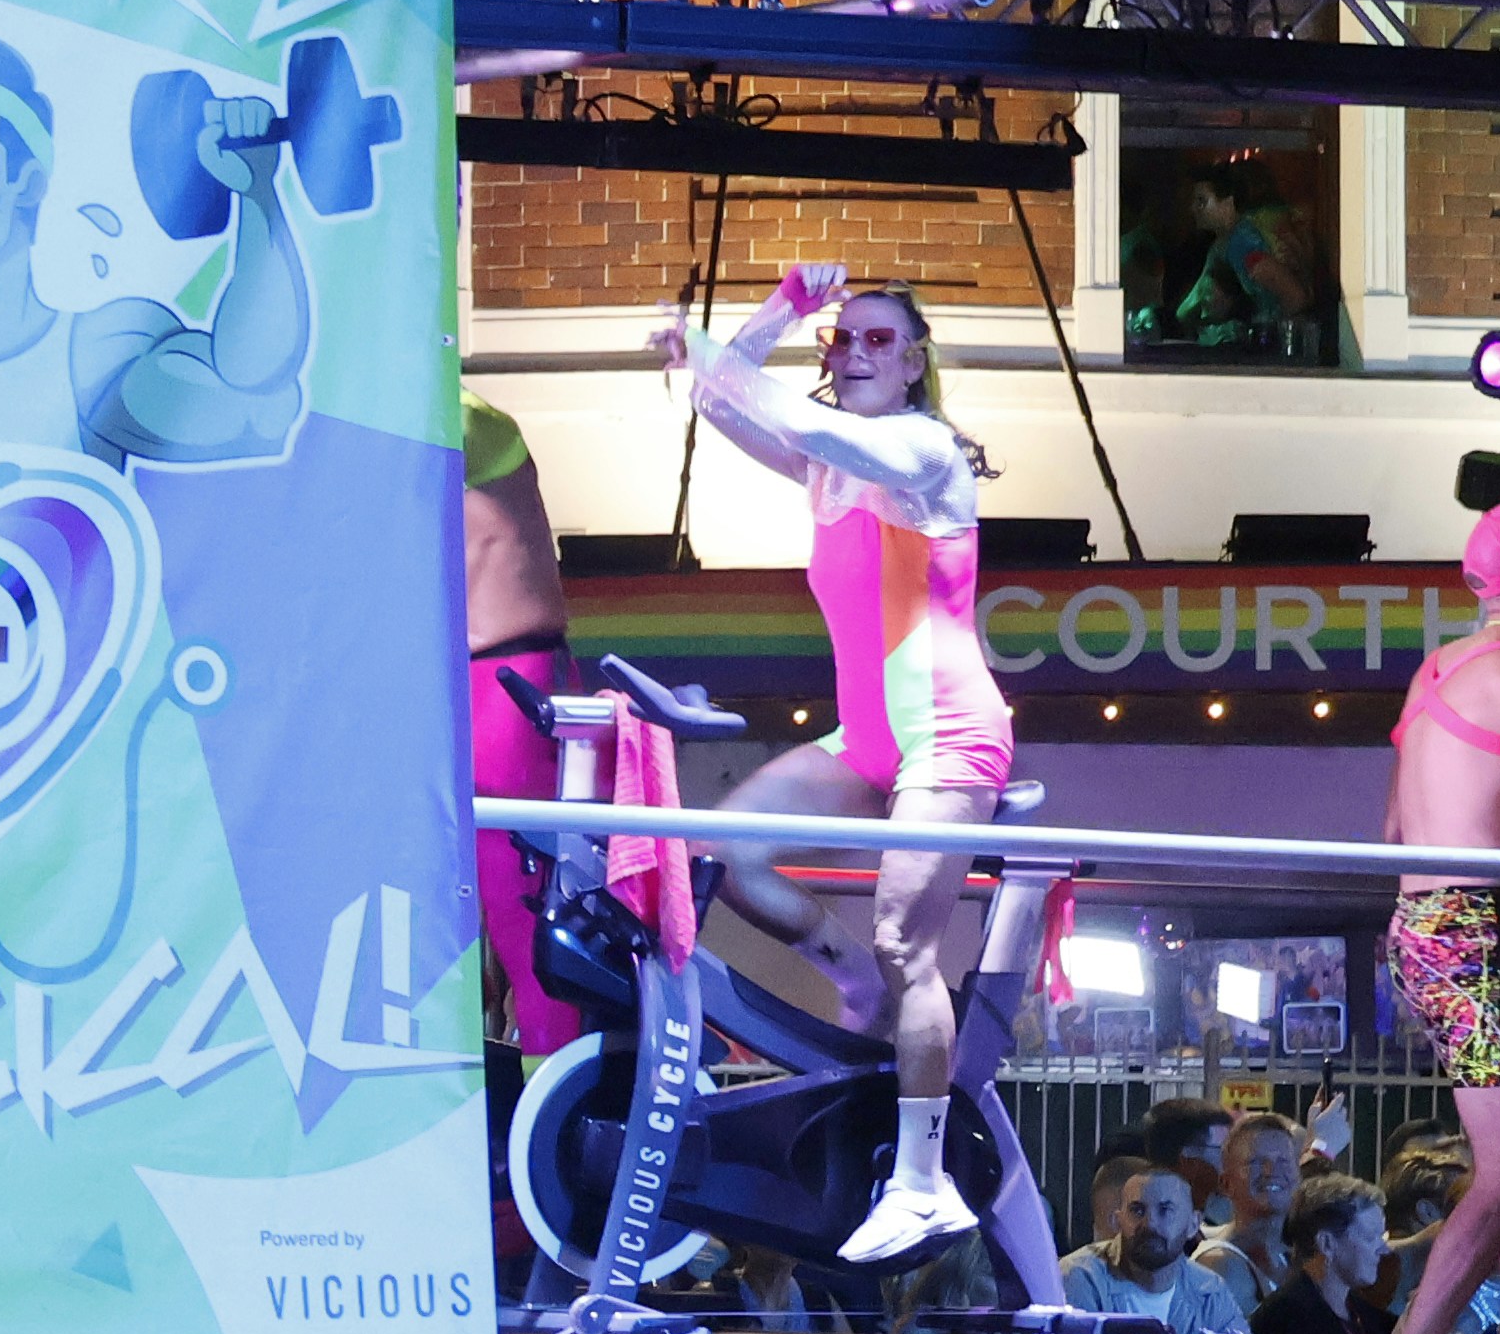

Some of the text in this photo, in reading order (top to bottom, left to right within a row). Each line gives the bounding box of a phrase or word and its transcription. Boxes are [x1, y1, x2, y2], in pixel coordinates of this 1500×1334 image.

[608, 1018, 691, 1289] VICIOUS CYCLE
[259, 1230, 365, 1250] Powered by
[266, 1272, 473, 1320] VICIOUS
